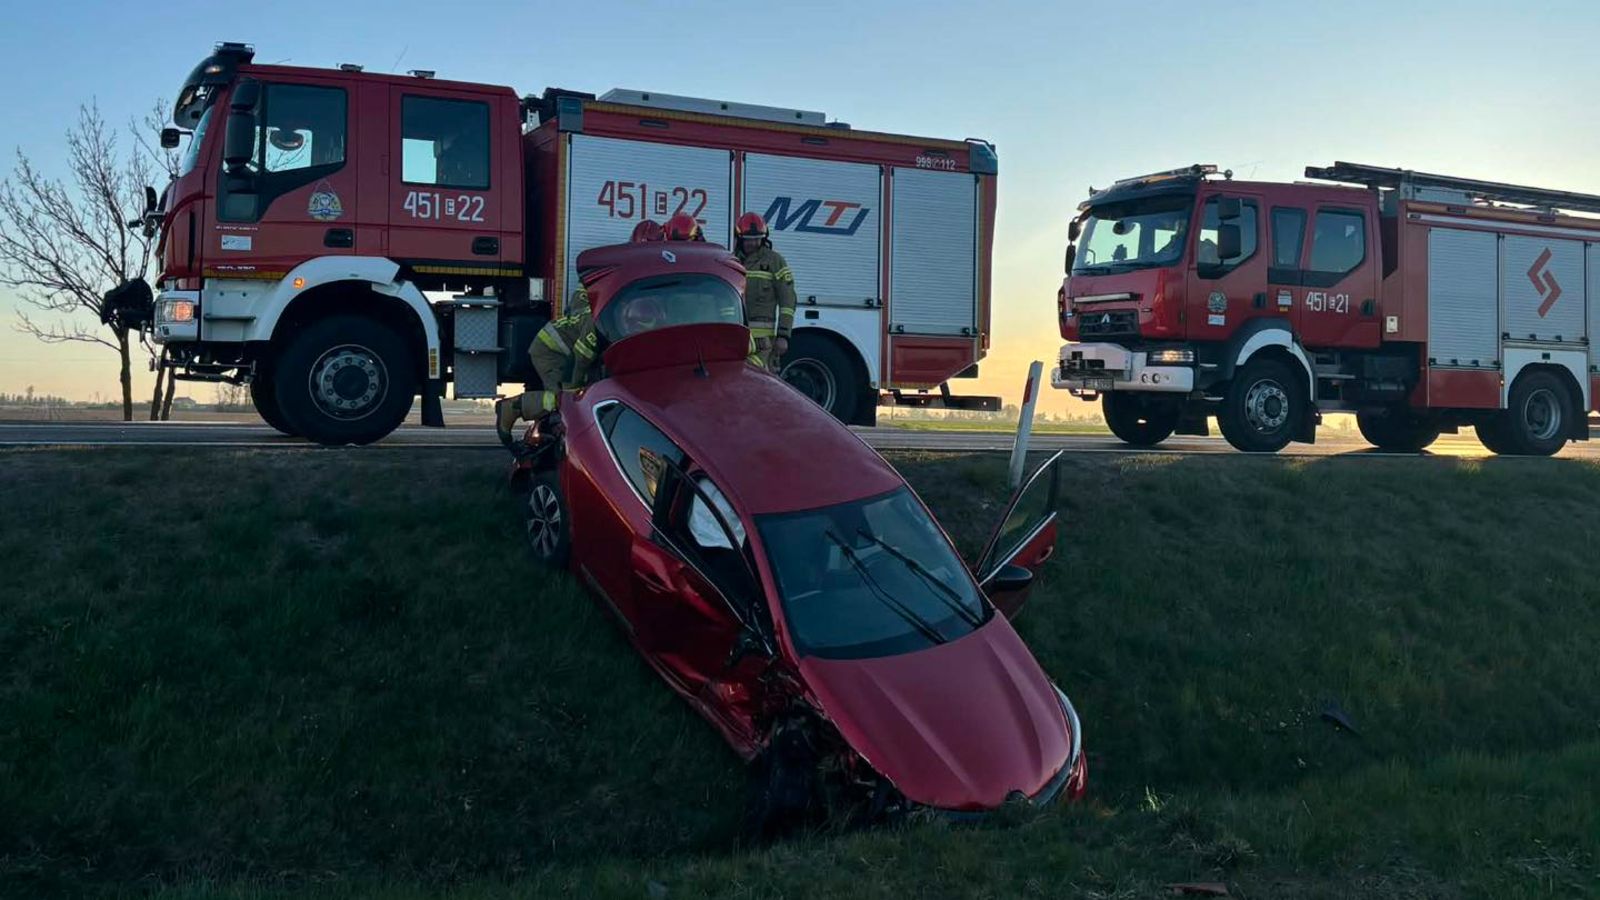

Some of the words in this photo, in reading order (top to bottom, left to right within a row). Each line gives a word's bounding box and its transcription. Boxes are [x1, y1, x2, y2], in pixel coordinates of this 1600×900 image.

[915, 156, 931, 168] 998
[941, 159, 955, 170] 112
[403, 191, 440, 219] 451
[457, 195, 484, 221] 22
[598, 180, 647, 219] 451
[672, 187, 707, 224] 22
[1306, 291, 1327, 311] 451
[1336, 294, 1349, 313] 21
